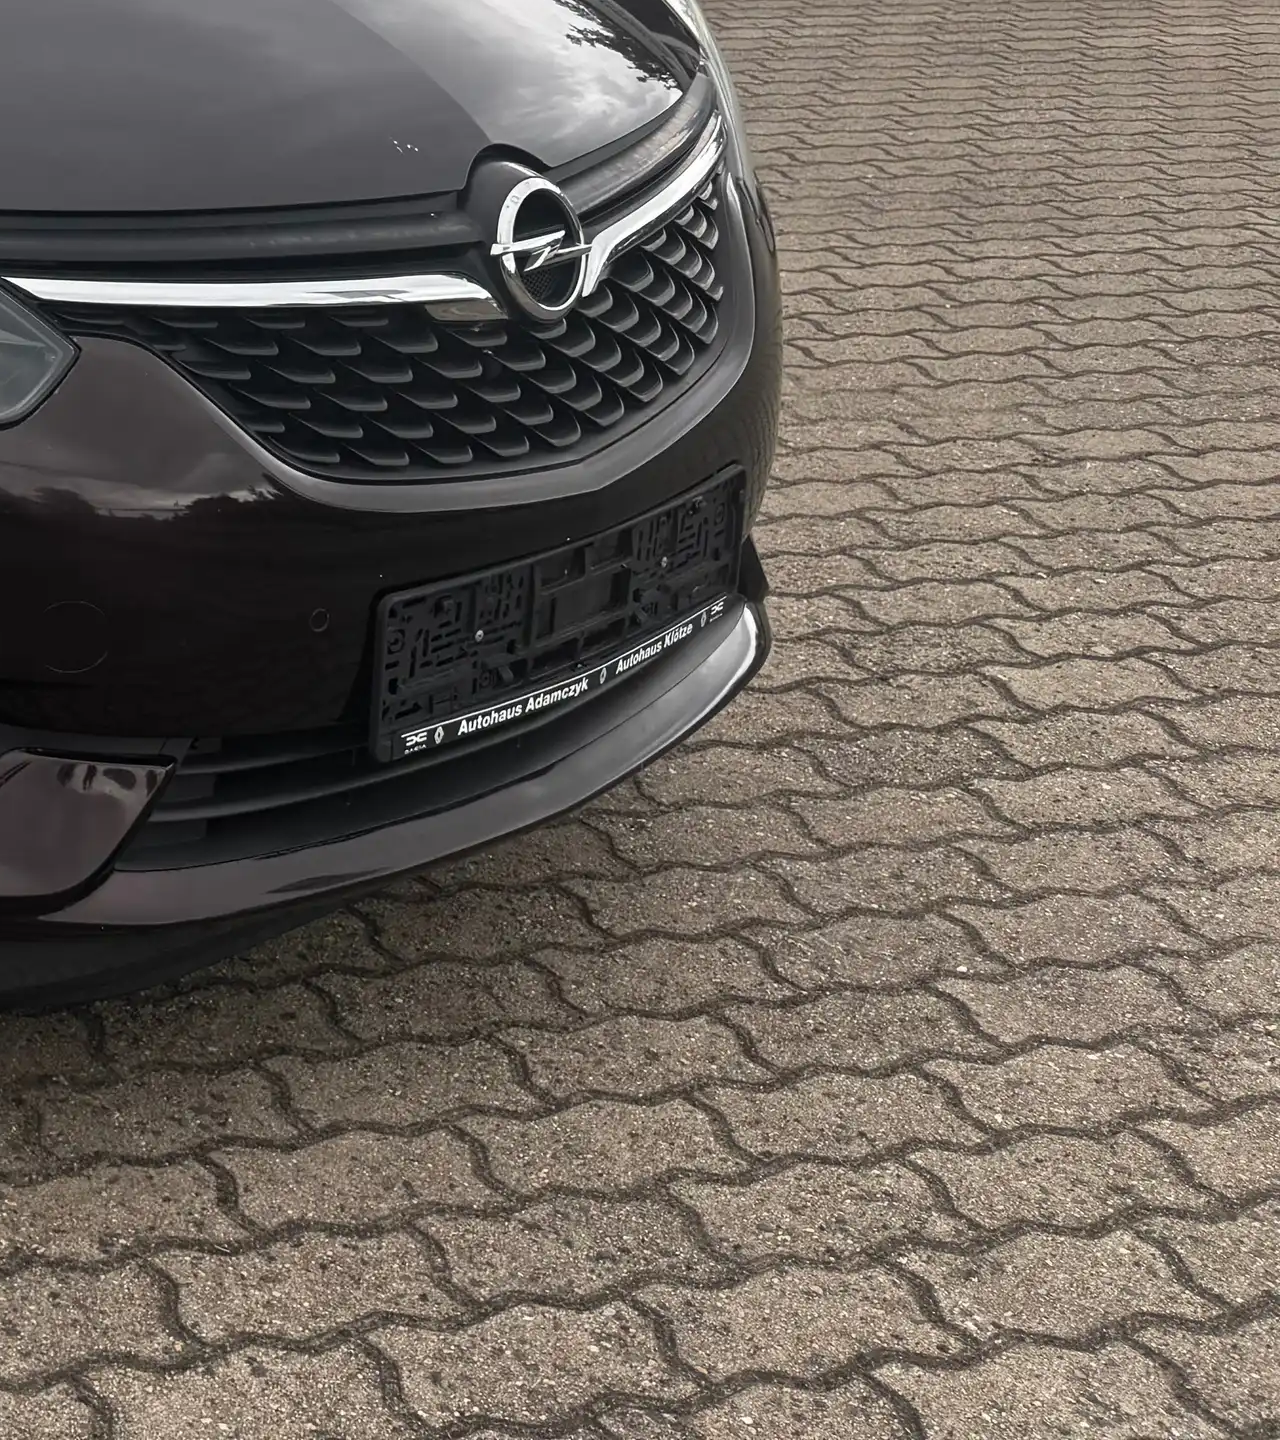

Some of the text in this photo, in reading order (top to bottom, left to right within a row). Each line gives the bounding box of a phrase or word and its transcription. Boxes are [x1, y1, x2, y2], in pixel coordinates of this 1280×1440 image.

[457, 703, 523, 736] Autohaus
[525, 677, 589, 713] Adamczyk
[615, 640, 662, 675] Autohaus
[663, 622, 693, 649] Klötze
